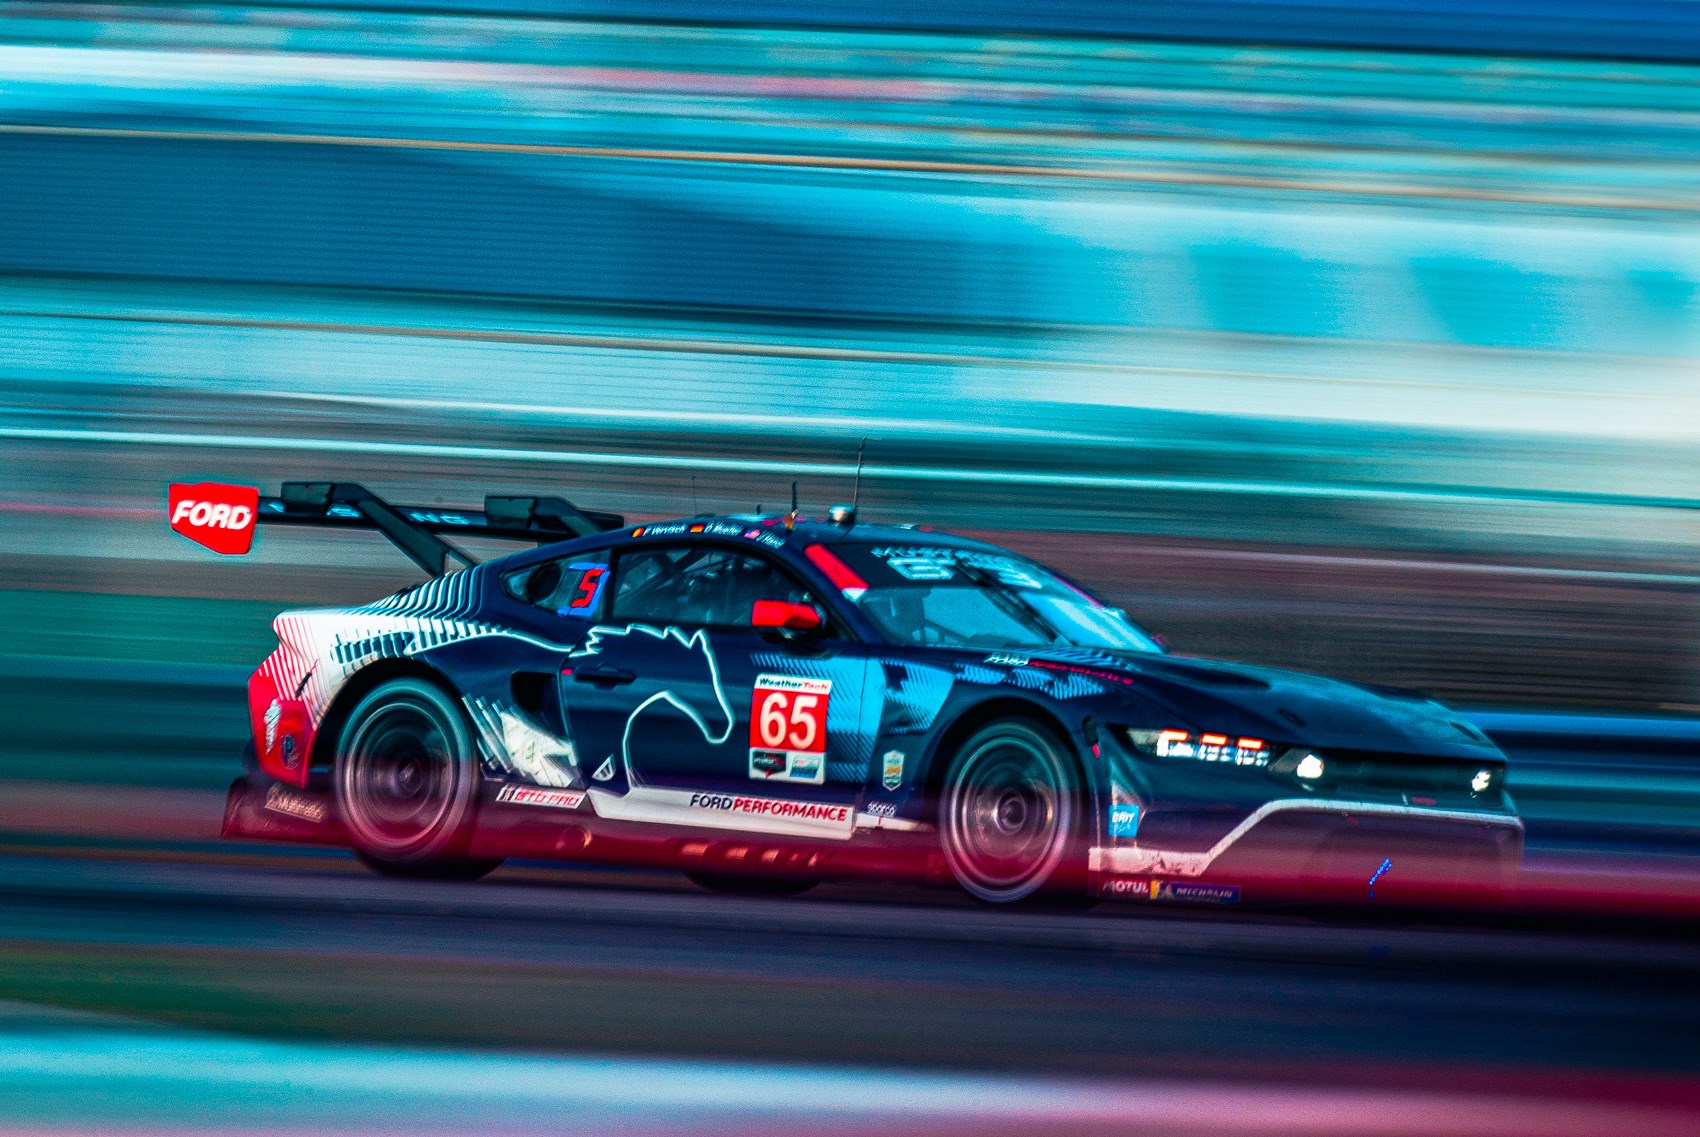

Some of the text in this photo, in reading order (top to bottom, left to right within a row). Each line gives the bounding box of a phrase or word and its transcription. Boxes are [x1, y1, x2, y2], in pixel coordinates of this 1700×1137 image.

[171, 499, 252, 530] FORD
[760, 678, 828, 690] WeatherTech
[760, 692, 818, 750] 65
[1102, 880, 1150, 894] MOTUL
